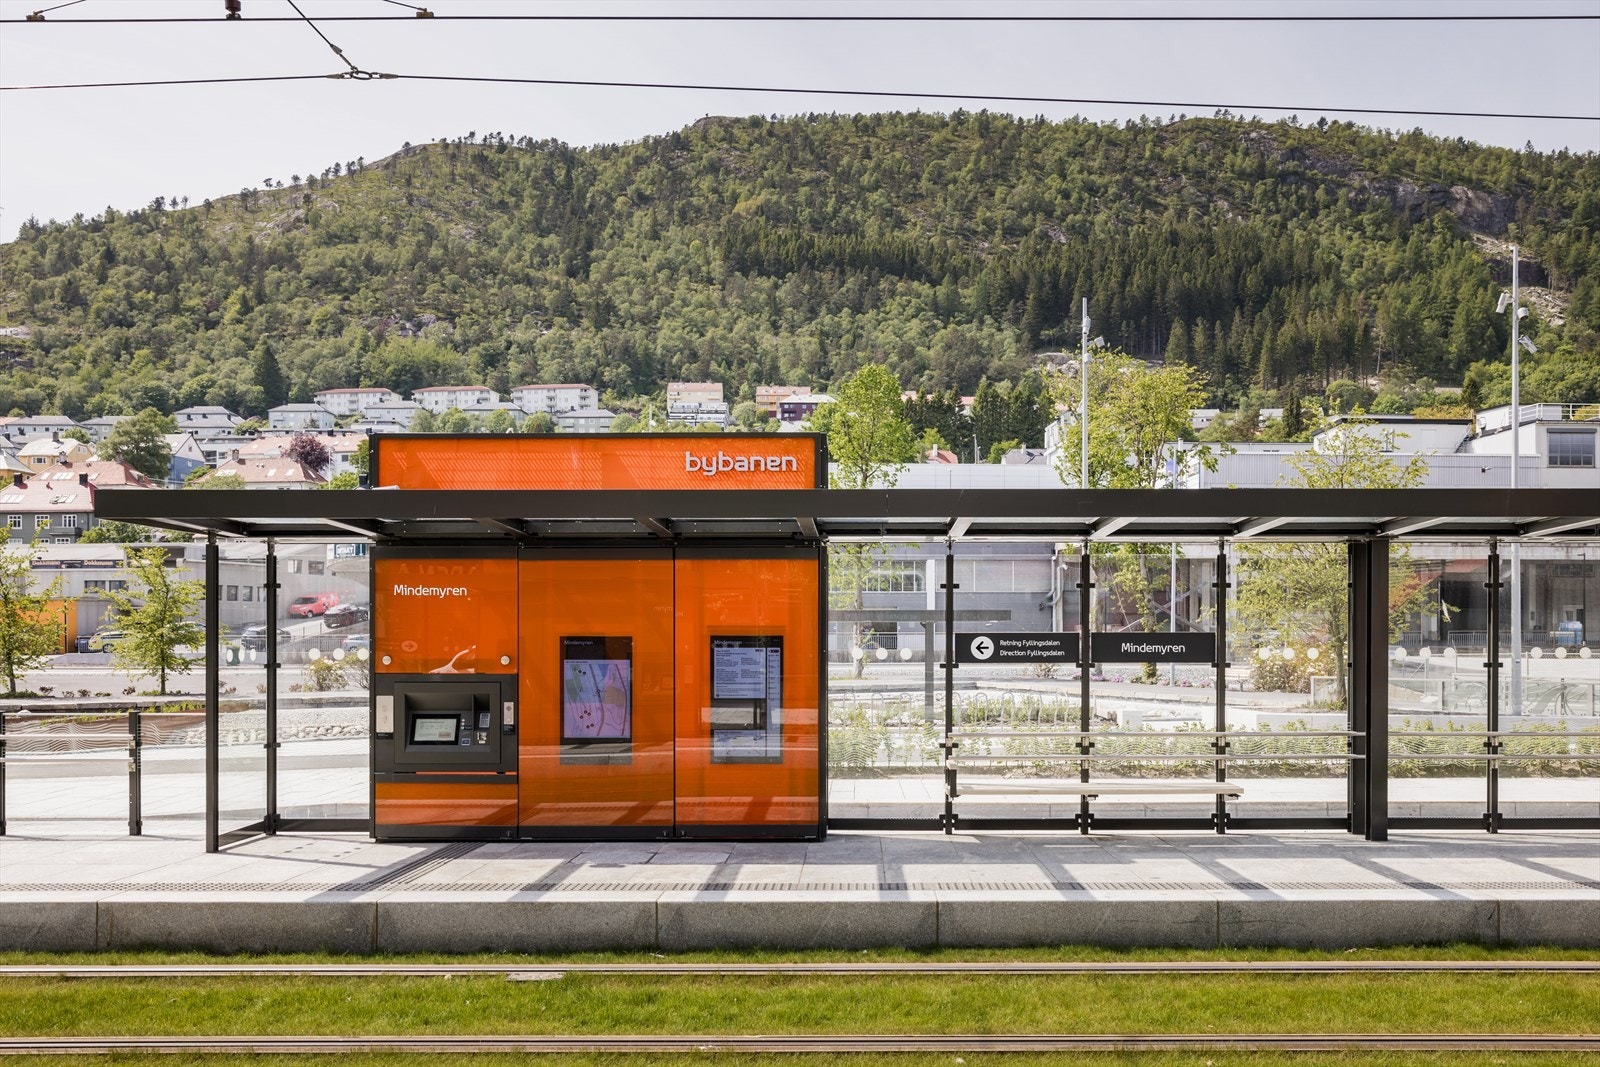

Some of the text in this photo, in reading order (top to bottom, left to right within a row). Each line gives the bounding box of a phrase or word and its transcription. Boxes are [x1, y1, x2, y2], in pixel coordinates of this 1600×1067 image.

[685, 451, 797, 476] bybanen
[393, 584, 468, 599] Mindemyren
[1121, 642, 1186, 655] Mindemyren
